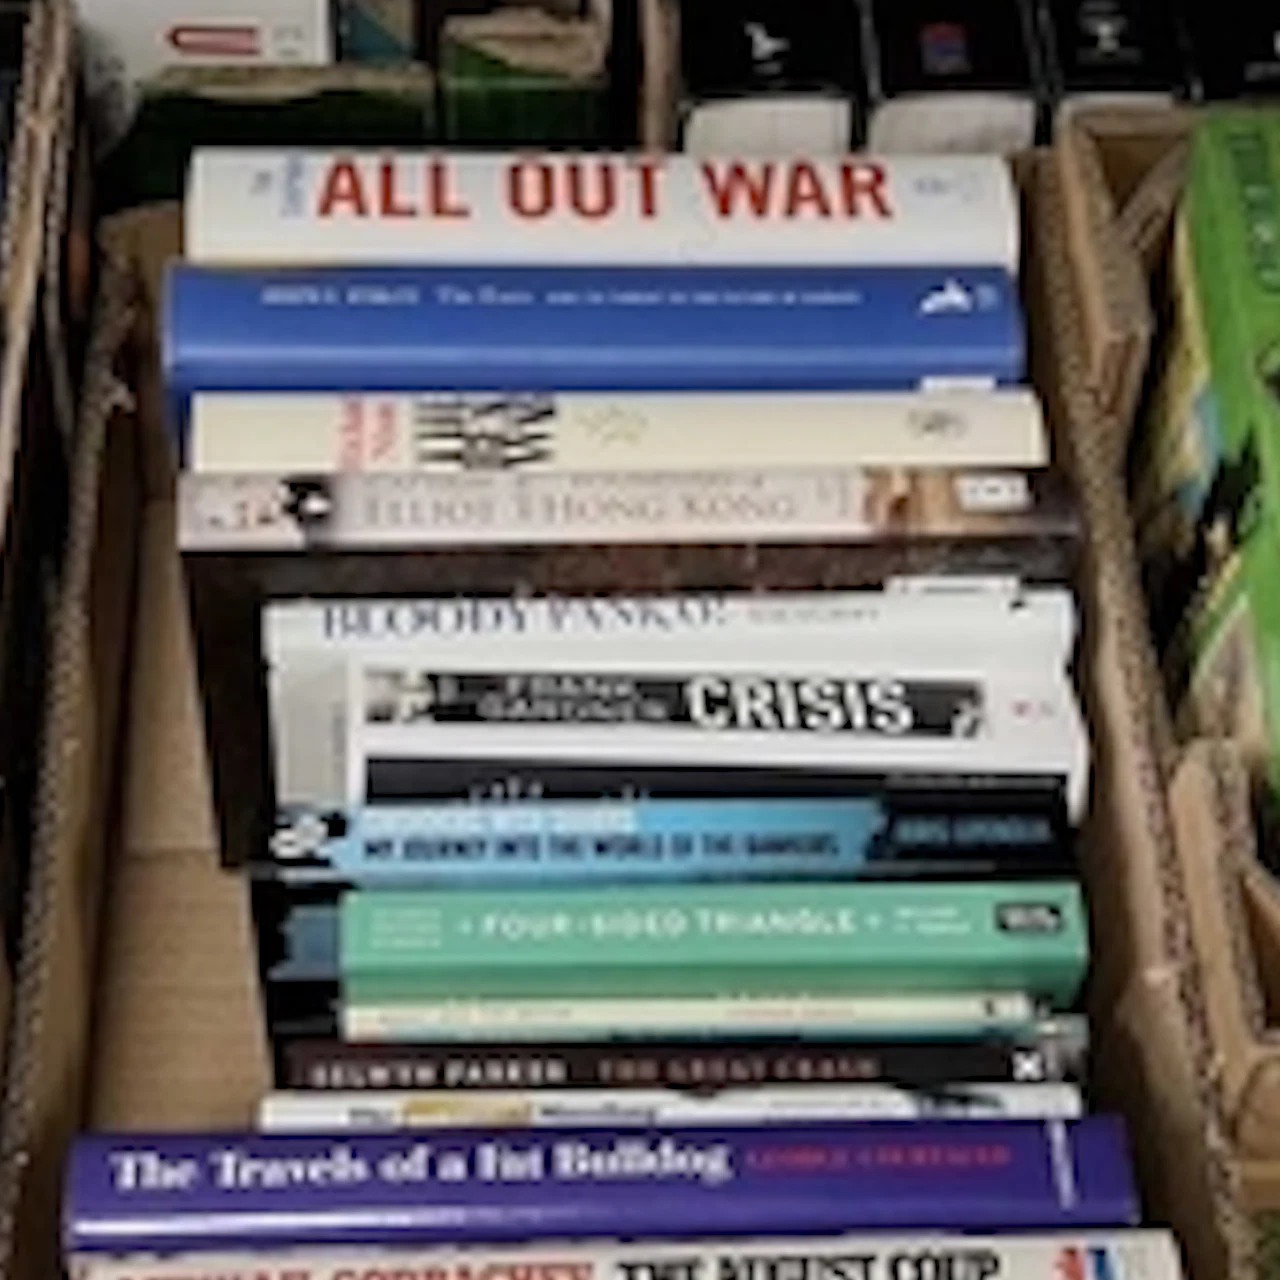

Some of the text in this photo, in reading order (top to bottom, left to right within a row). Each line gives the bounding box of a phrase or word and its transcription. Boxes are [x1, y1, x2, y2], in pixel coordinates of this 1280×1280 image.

[318, 157, 894, 220] ALL OUT WAR
[683, 675, 913, 734] CRISIS
[110, 1151, 200, 1189] The
[210, 1147, 369, 1187] Travels
[379, 1145, 431, 1181] of
[435, 1153, 467, 1181] a
[553, 1140, 734, 1186] Bulldog
